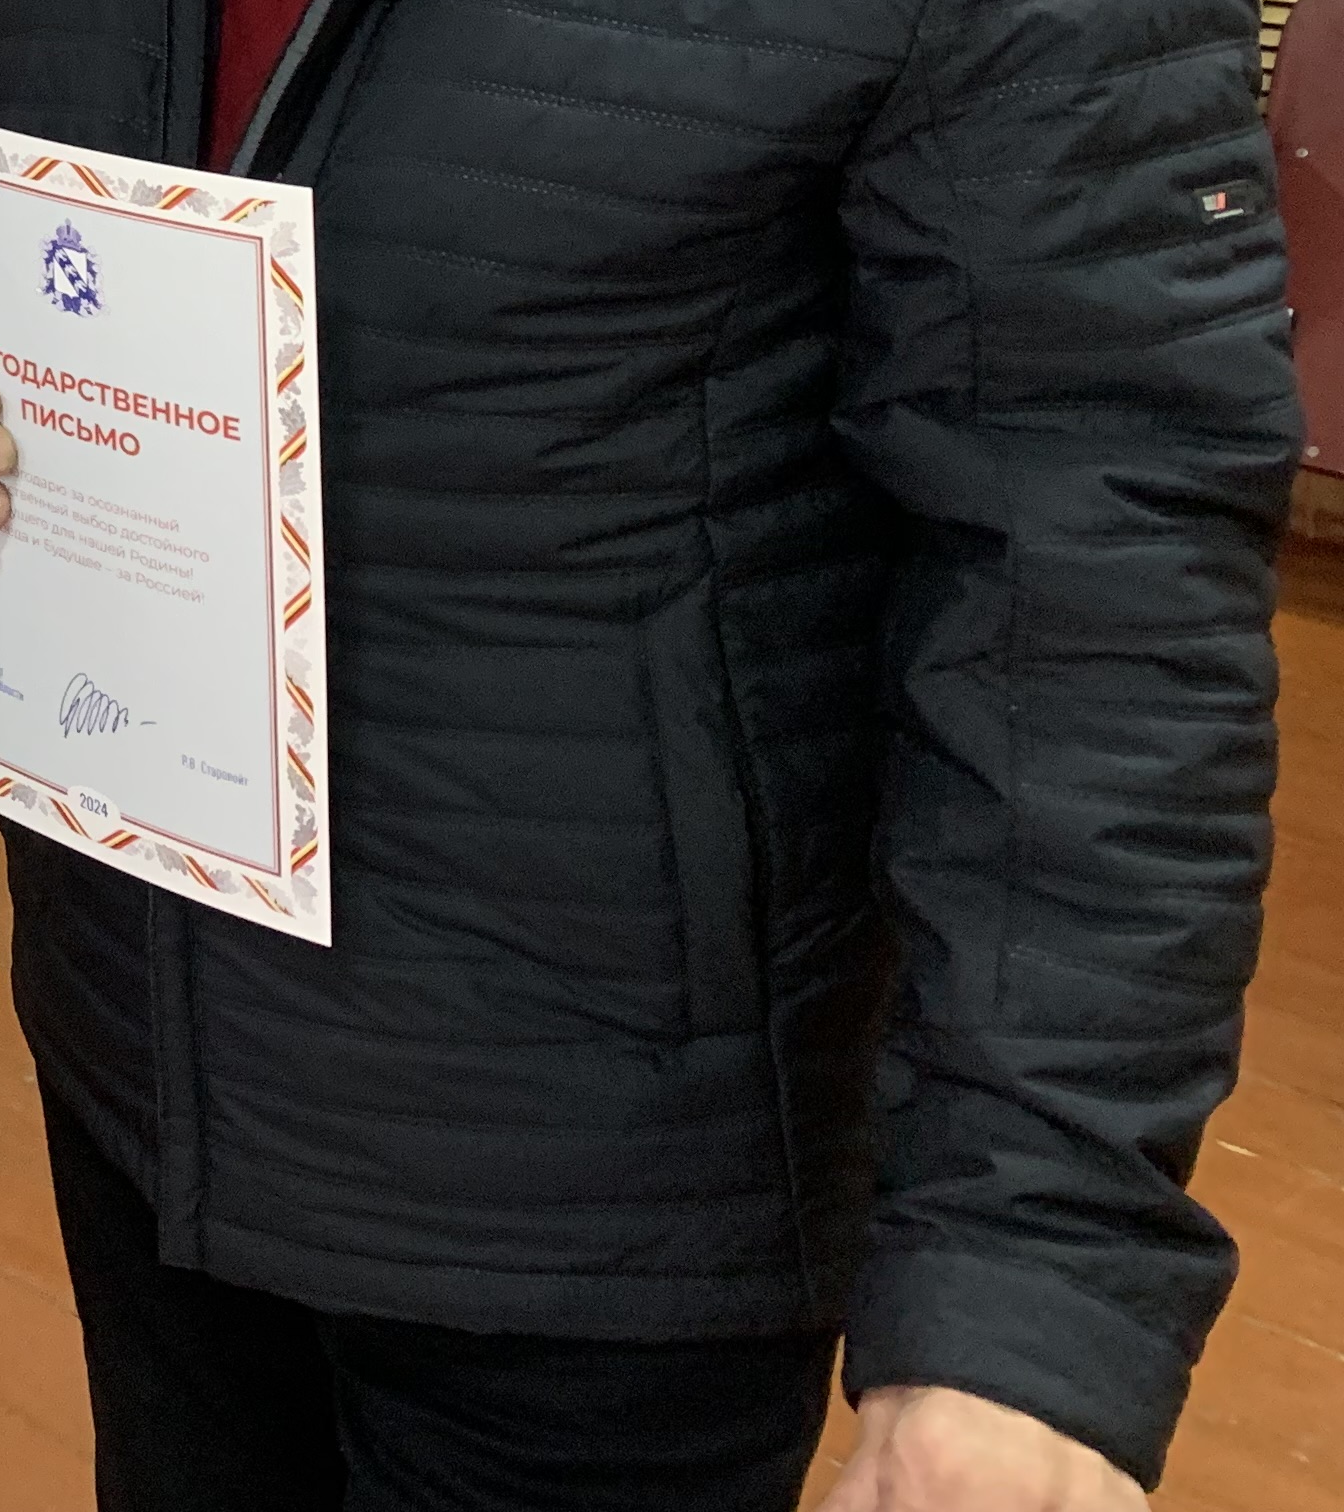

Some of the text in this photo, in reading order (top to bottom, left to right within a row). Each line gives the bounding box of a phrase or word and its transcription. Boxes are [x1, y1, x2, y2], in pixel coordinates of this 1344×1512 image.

[20, 397, 141, 457] ПИСЬМО
[72, 489, 85, 503] за
[87, 496, 180, 533] осознанный
[32, 536, 40, 546] и
[44, 538, 102, 571] Будущее
[117, 569, 132, 582] за
[52, 524, 75, 540] для
[79, 534, 126, 559] нашей
[130, 549, 194, 580] Родины!
[72, 511, 118, 536] выбор
[120, 528, 210, 563] достойного
[79, 792, 109, 818] 2024
